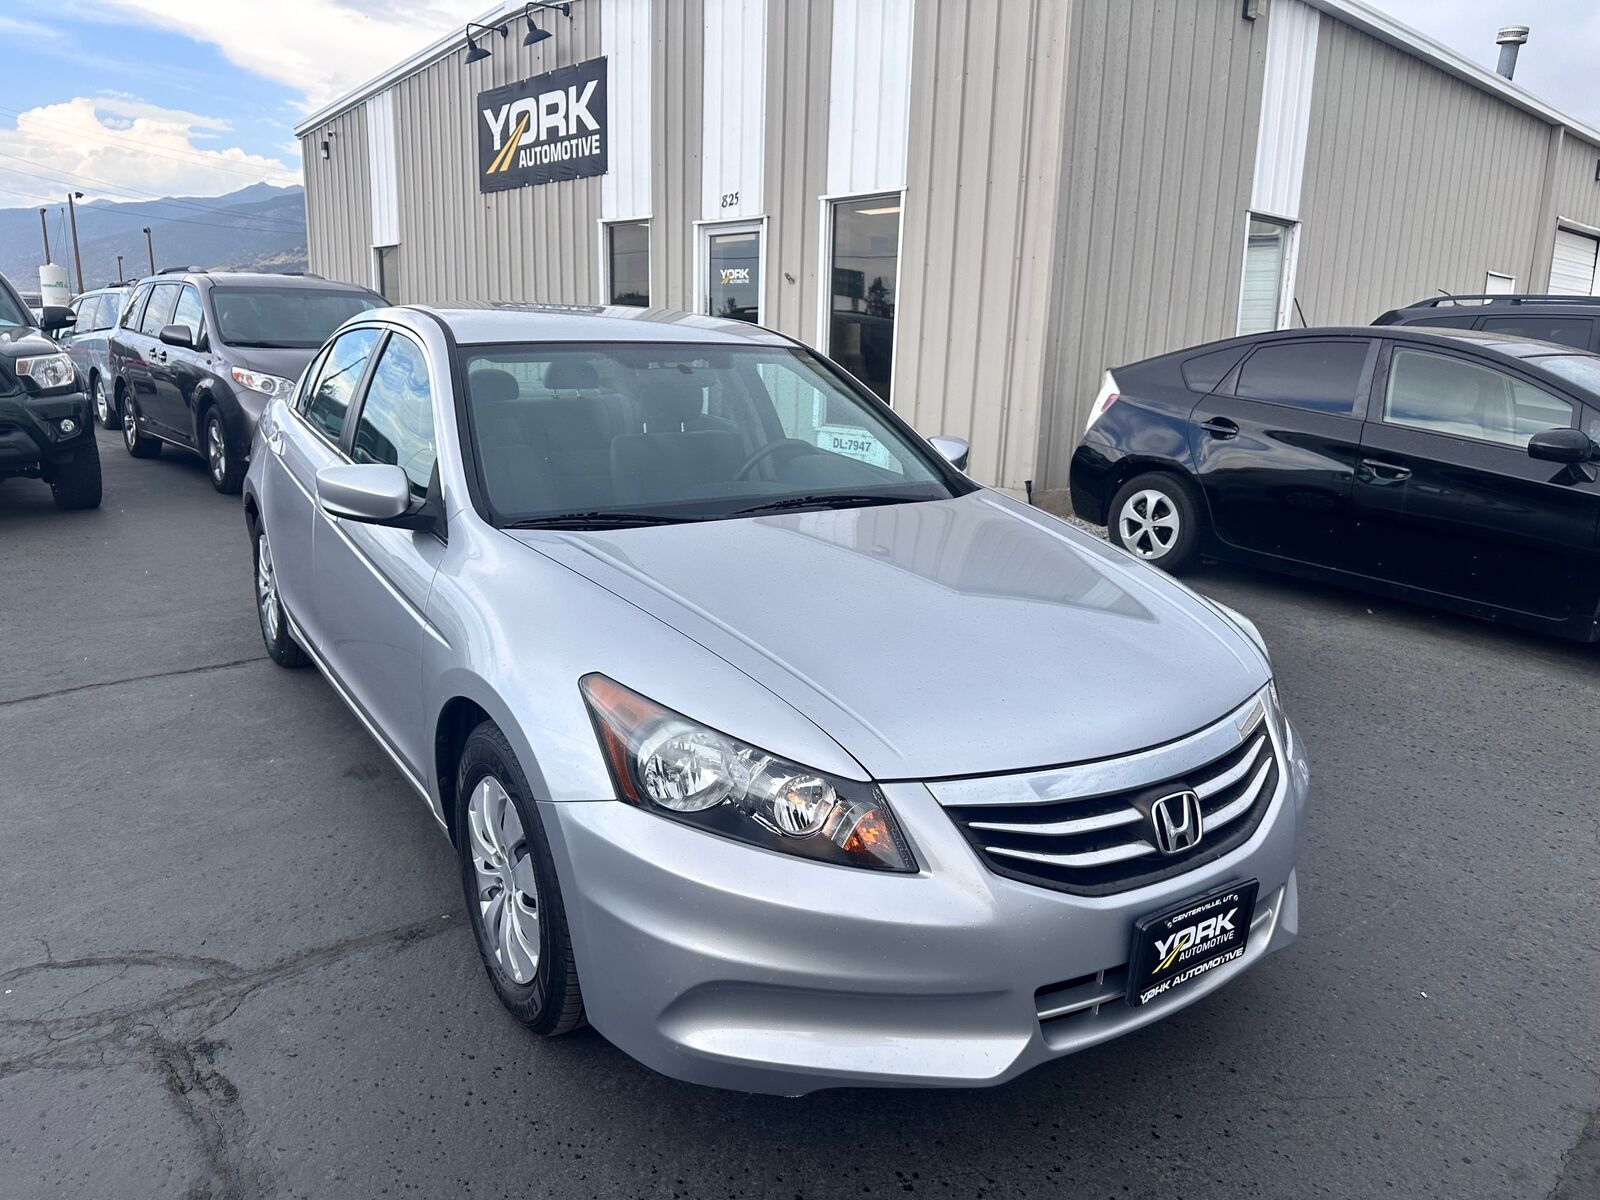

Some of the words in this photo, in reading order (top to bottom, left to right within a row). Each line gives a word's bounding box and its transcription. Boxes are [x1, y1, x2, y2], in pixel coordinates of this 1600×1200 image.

[482, 80, 600, 151] YORK
[518, 134, 600, 168] AUTOMOTIVE
[721, 191, 739, 208] 825
[720, 268, 749, 279] YORK
[833, 438, 872, 452] DL:7947
[1172, 899, 1222, 923] CENTERVILLE,
[1223, 894, 1233, 903] UT
[1154, 907, 1238, 961] YORK
[1179, 930, 1235, 962] AUTOMOTIVE
[1172, 947, 1244, 986] AUTOMOTIVE
